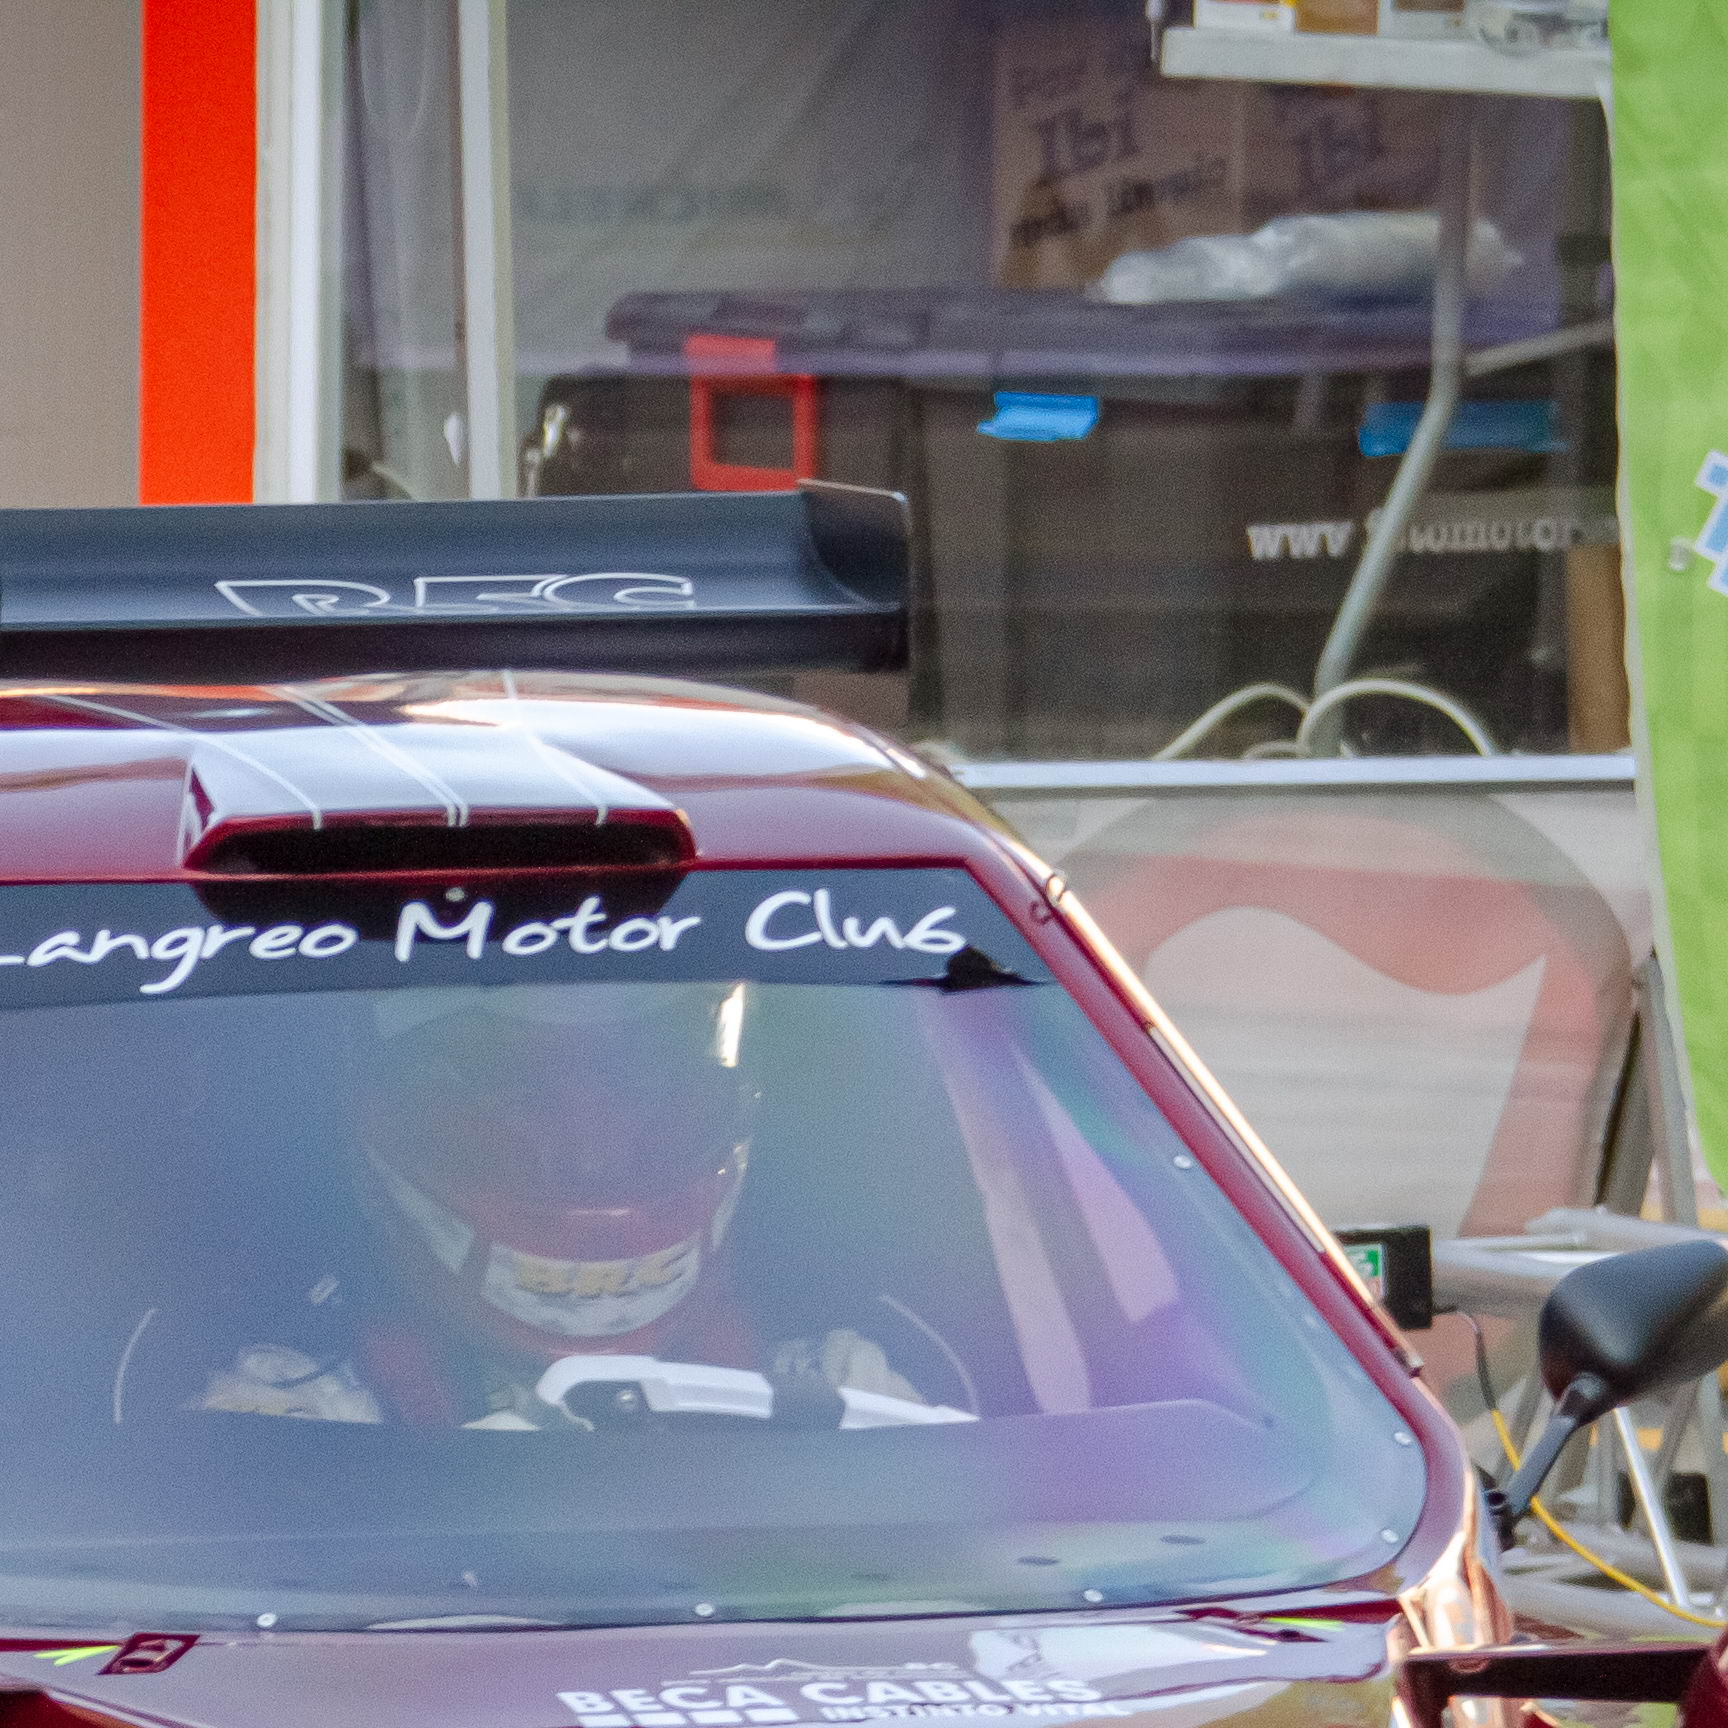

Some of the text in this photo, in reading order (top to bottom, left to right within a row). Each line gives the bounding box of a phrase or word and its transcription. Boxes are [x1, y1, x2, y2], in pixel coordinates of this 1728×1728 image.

[394, 898, 700, 962] Motor
[557, 1677, 1104, 1716] BECA CABLES
